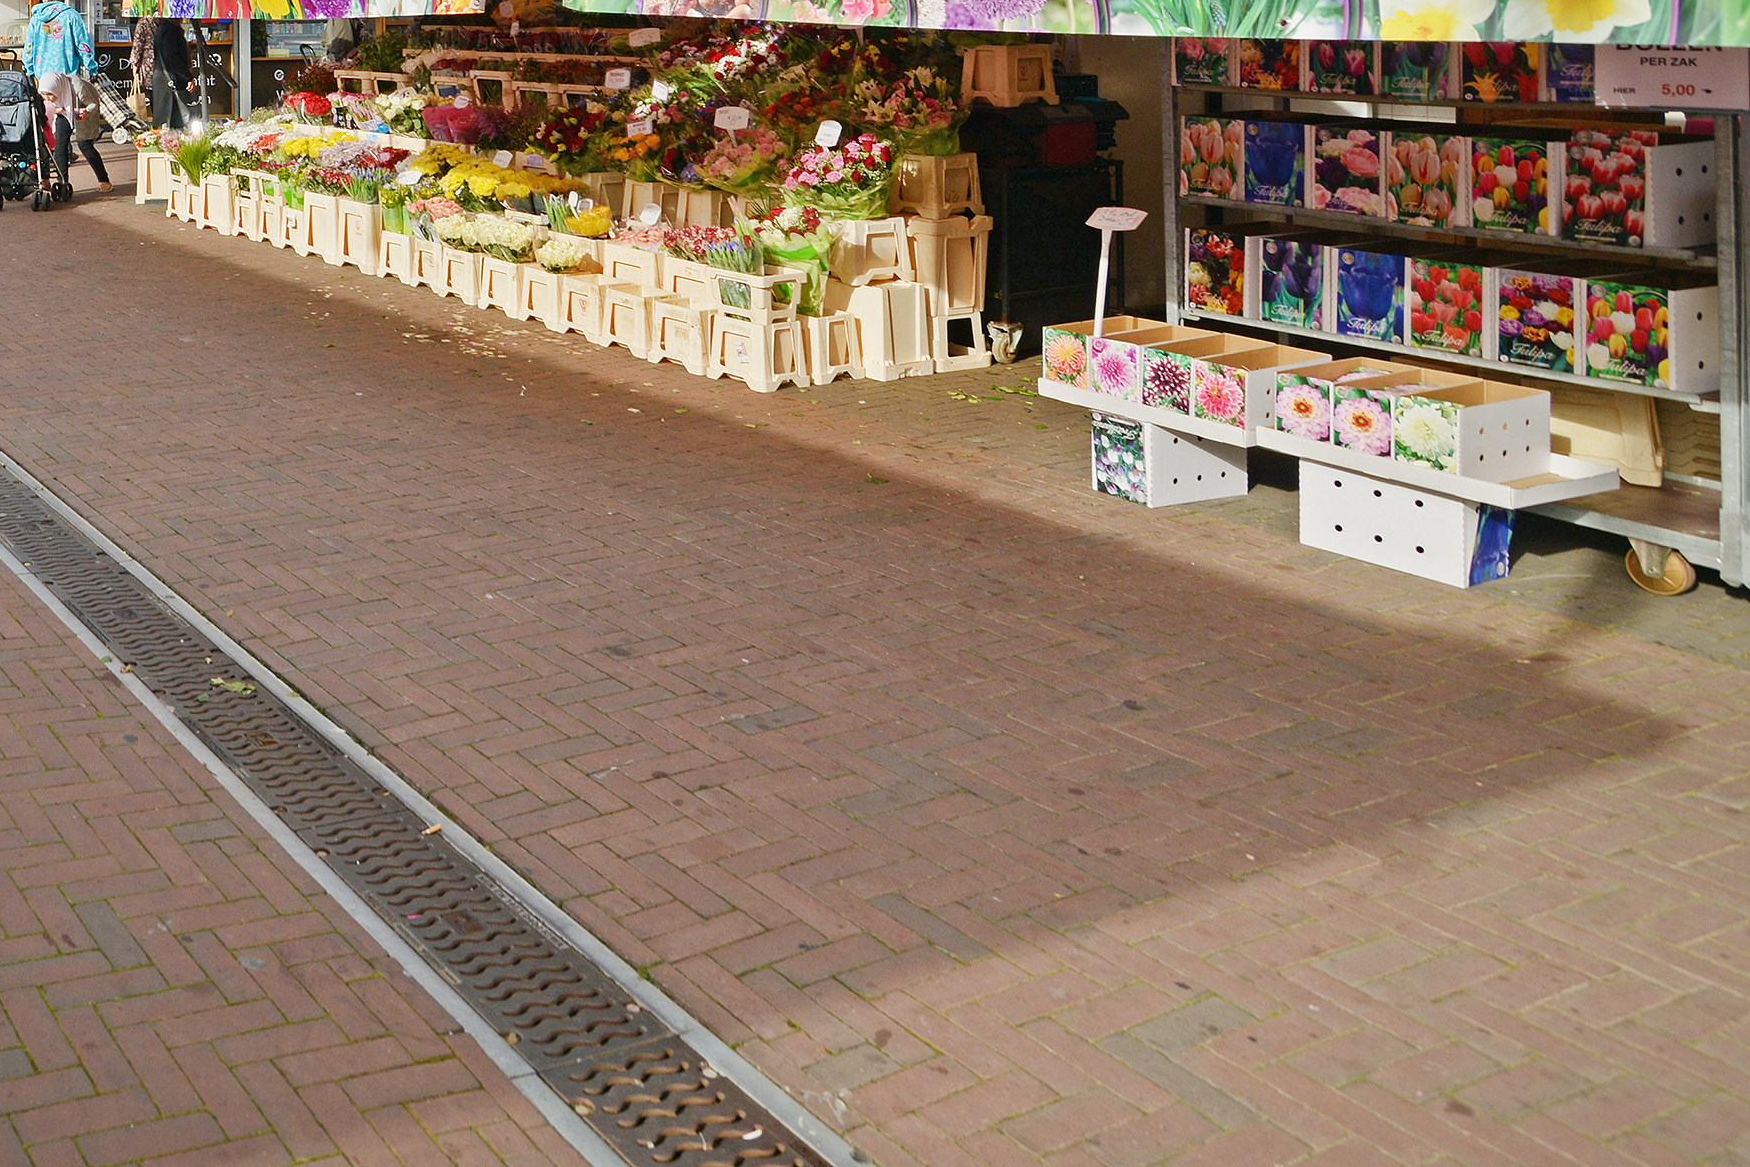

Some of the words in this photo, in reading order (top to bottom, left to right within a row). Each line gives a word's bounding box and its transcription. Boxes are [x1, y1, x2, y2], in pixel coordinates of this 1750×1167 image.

[1640, 57, 1667, 66] PER
[1670, 57, 1698, 67] ZAK
[1319, 73, 1357, 89] Tulipa
[1391, 76, 1430, 91] Tulipa
[1661, 84, 1696, 97] 5,00
[1254, 186, 1288, 201] Tulipa
[1490, 210, 1531, 228] Tulipa
[1575, 218, 1624, 236] Tulipa
[1271, 304, 1307, 319] Tulipa
[1347, 317, 1387, 334] Tulipa
[1421, 330, 1464, 347] Tulipa
[1511, 342, 1556, 360] Tulipa
[1606, 357, 1647, 376] Tulipa
